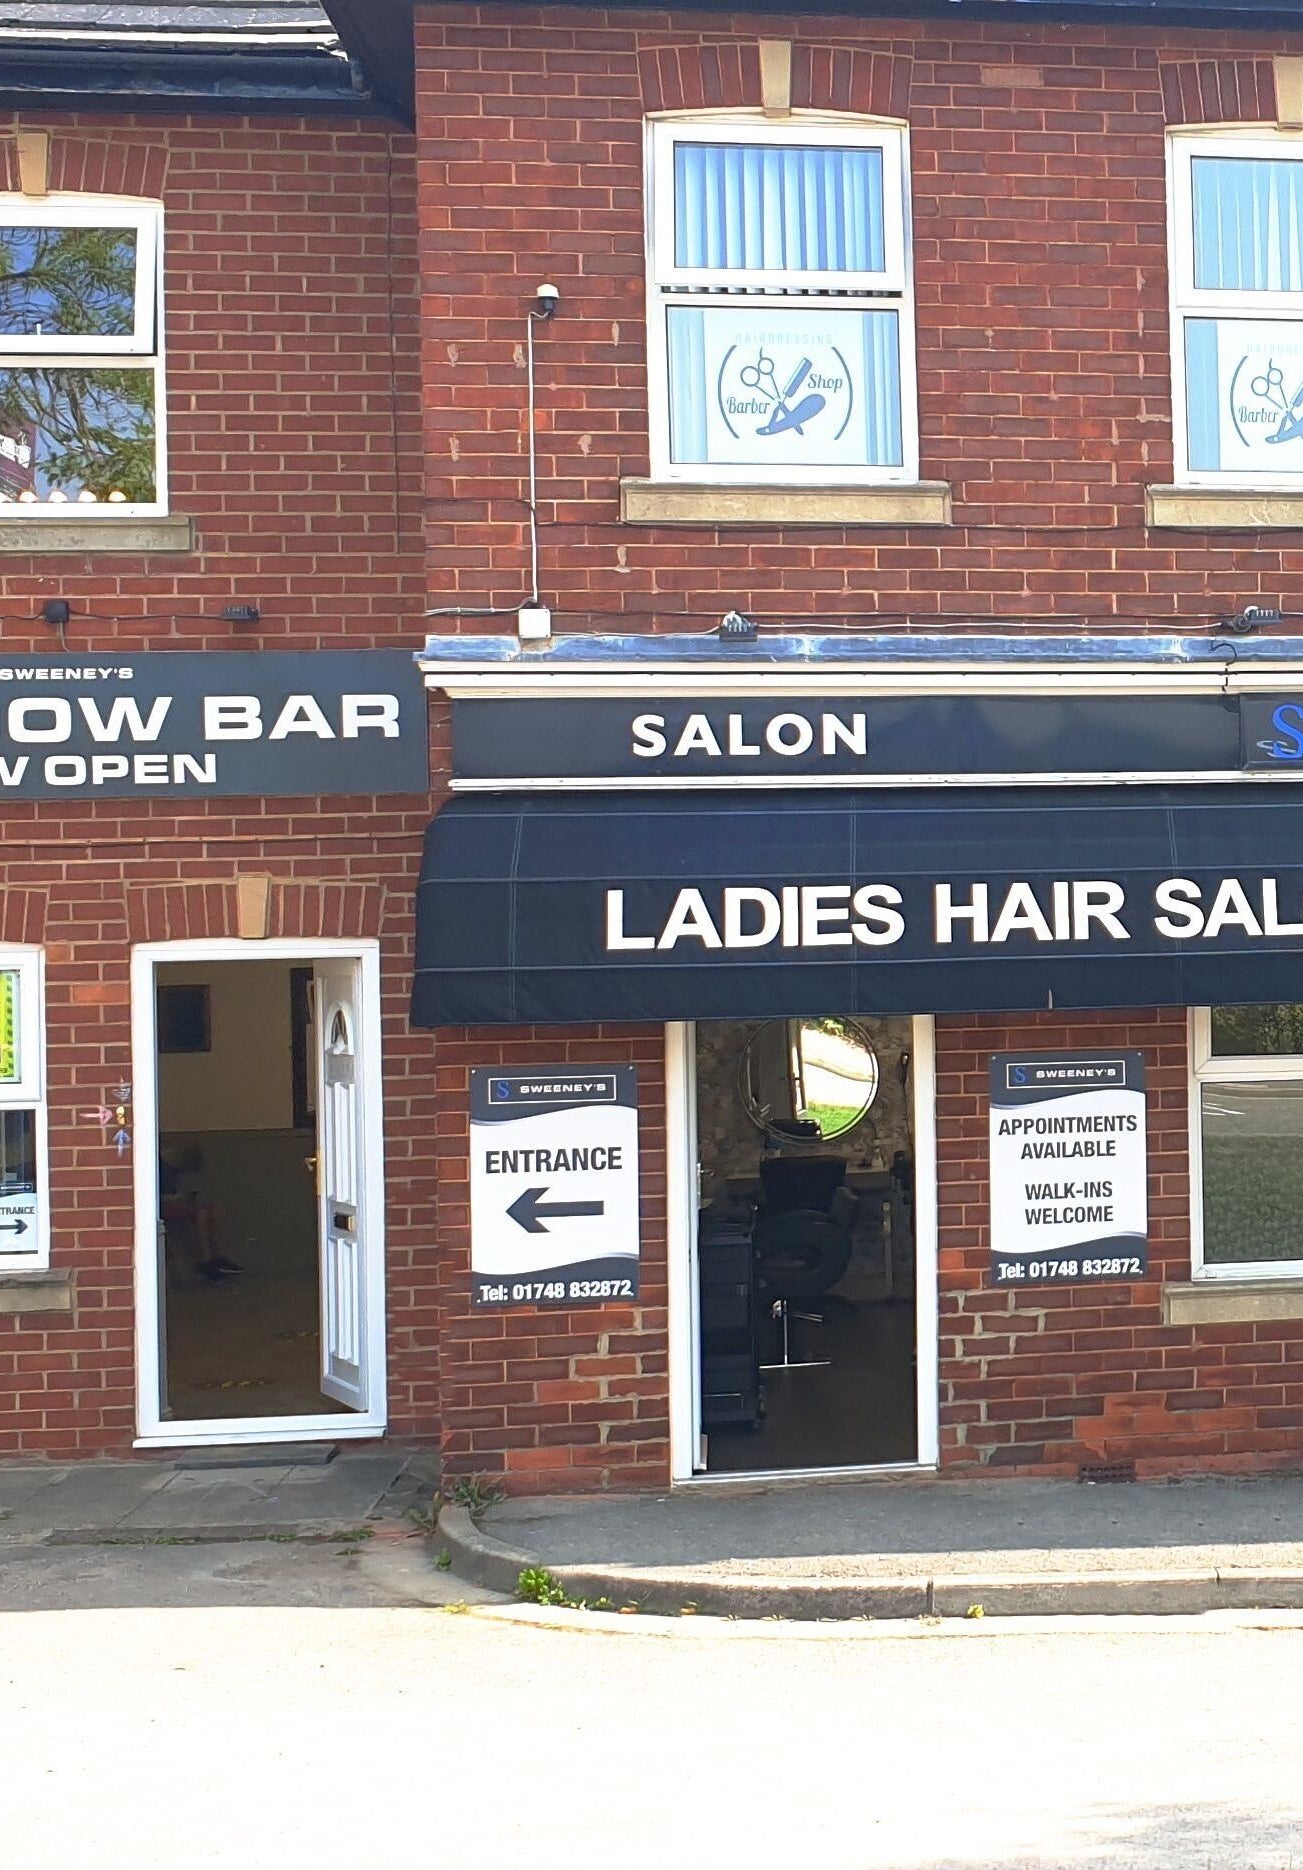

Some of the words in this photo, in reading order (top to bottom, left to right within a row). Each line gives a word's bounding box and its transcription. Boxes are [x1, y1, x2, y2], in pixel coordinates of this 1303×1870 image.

[726, 397, 770, 414] Barber
[807, 373, 843, 393] Shop
[1238, 406, 1280, 424] Barber
[0, 667, 134, 681] SWEENEY'S
[204, 694, 400, 741] BAR
[632, 713, 868, 757] SALON
[44, 753, 217, 786] OPEN
[605, 883, 905, 951] LADIES
[935, 879, 1131, 944] HAIR
[1035, 1068, 1117, 1080] SWEENEY'S
[519, 1083, 607, 1095] SWEENEY'S
[998, 1114, 1138, 1136] APPOINTMENTS
[485, 1146, 623, 1174] ENTRANCE
[1020, 1140, 1117, 1160] AVAILABLE
[1025, 1180, 1113, 1200] WALK-INS
[1025, 1205, 1114, 1225] WELCOME
[998, 1263, 1026, 1279] Tel:
[1029, 1260, 1079, 1278] 01748
[1082, 1257, 1141, 1275] 832872
[479, 1284, 509, 1301] Tel:
[512, 1282, 563, 1300] 01748
[569, 1279, 632, 1298] 832872
